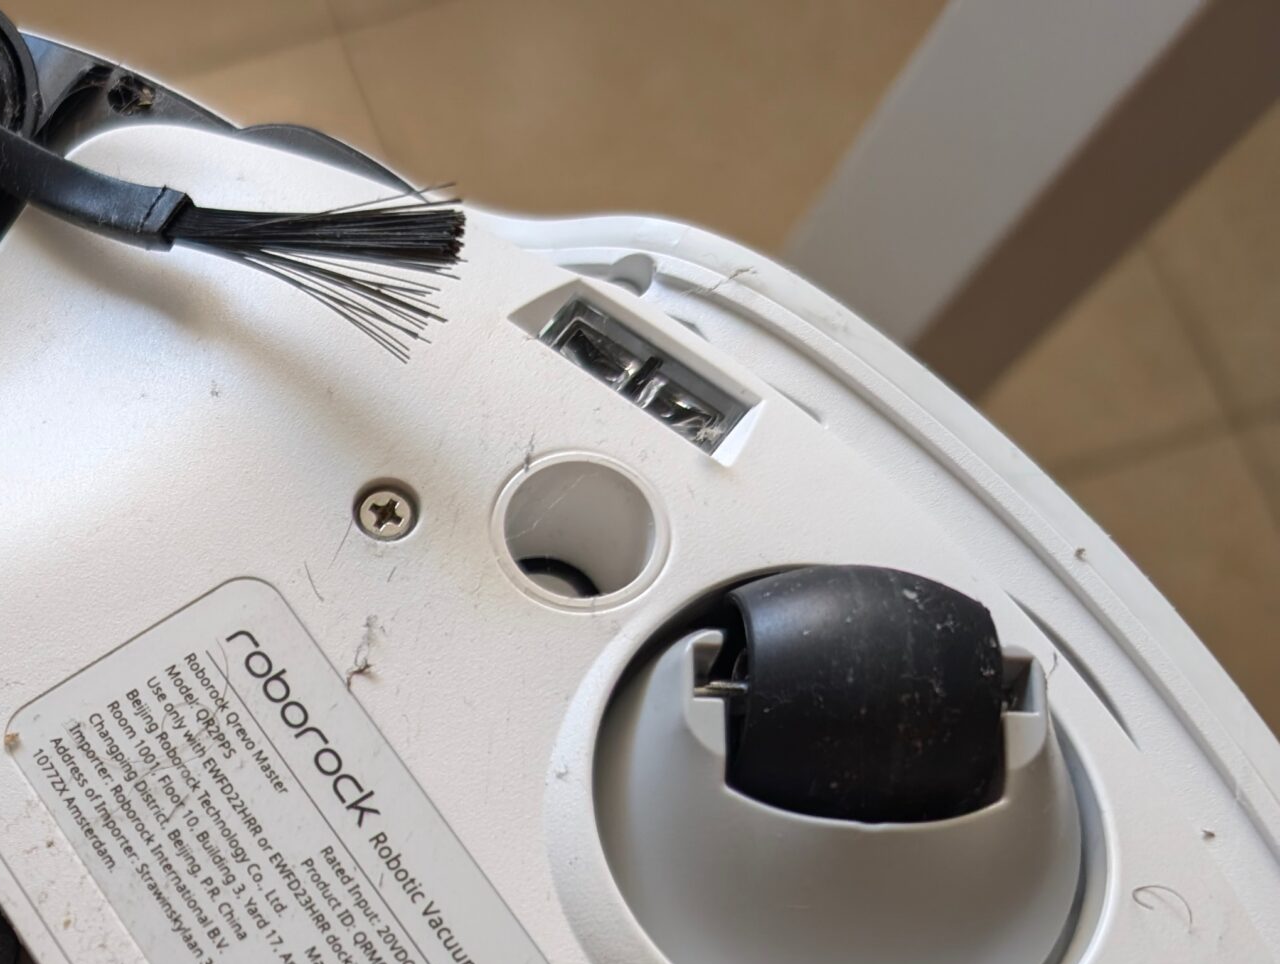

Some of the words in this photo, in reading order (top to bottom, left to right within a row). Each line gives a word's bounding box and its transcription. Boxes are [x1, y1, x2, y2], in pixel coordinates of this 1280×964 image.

[163, 663, 200, 709] Model:
[182, 651, 230, 713] Roborock
[224, 710, 256, 751] Qrevo
[251, 748, 289, 794] Master
[224, 629, 381, 829] roborock
[31, 747, 70, 797] 1077ZX
[61, 795, 116, 873] Amsterdam.
[48, 736, 89, 788] Address
[83, 786, 103, 802] of
[105, 699, 137, 740] Room
[156, 773, 184, 812] Floor
[194, 828, 237, 887] Building
[243, 895, 271, 930] Yard
[124, 687, 160, 735] Beijing
[154, 729, 201, 793] Roborock
[195, 788, 251, 864] Technology
[263, 887, 288, 918] Ltd.
[145, 674, 167, 703] Use
[162, 701, 187, 730] only
[182, 728, 207, 759] with
[201, 755, 263, 838] EWFD22HRR
[256, 836, 274, 852] or
[267, 850, 332, 934] EWFD23HRR
[67, 721, 114, 786] Importer:
[108, 782, 155, 846] Roborock
[149, 842, 214, 928] International
[205, 925, 230, 954] B.V.
[87, 711, 139, 783] Changping
[216, 900, 248, 942] China
[92, 799, 140, 864] Importer:
[367, 830, 426, 904] Robotic
[134, 861, 204, 959] Strawinskylaan
[299, 856, 342, 912] Product
[335, 907, 356, 932] ID:
[319, 844, 355, 886] Rated
[346, 882, 381, 926] Input:
